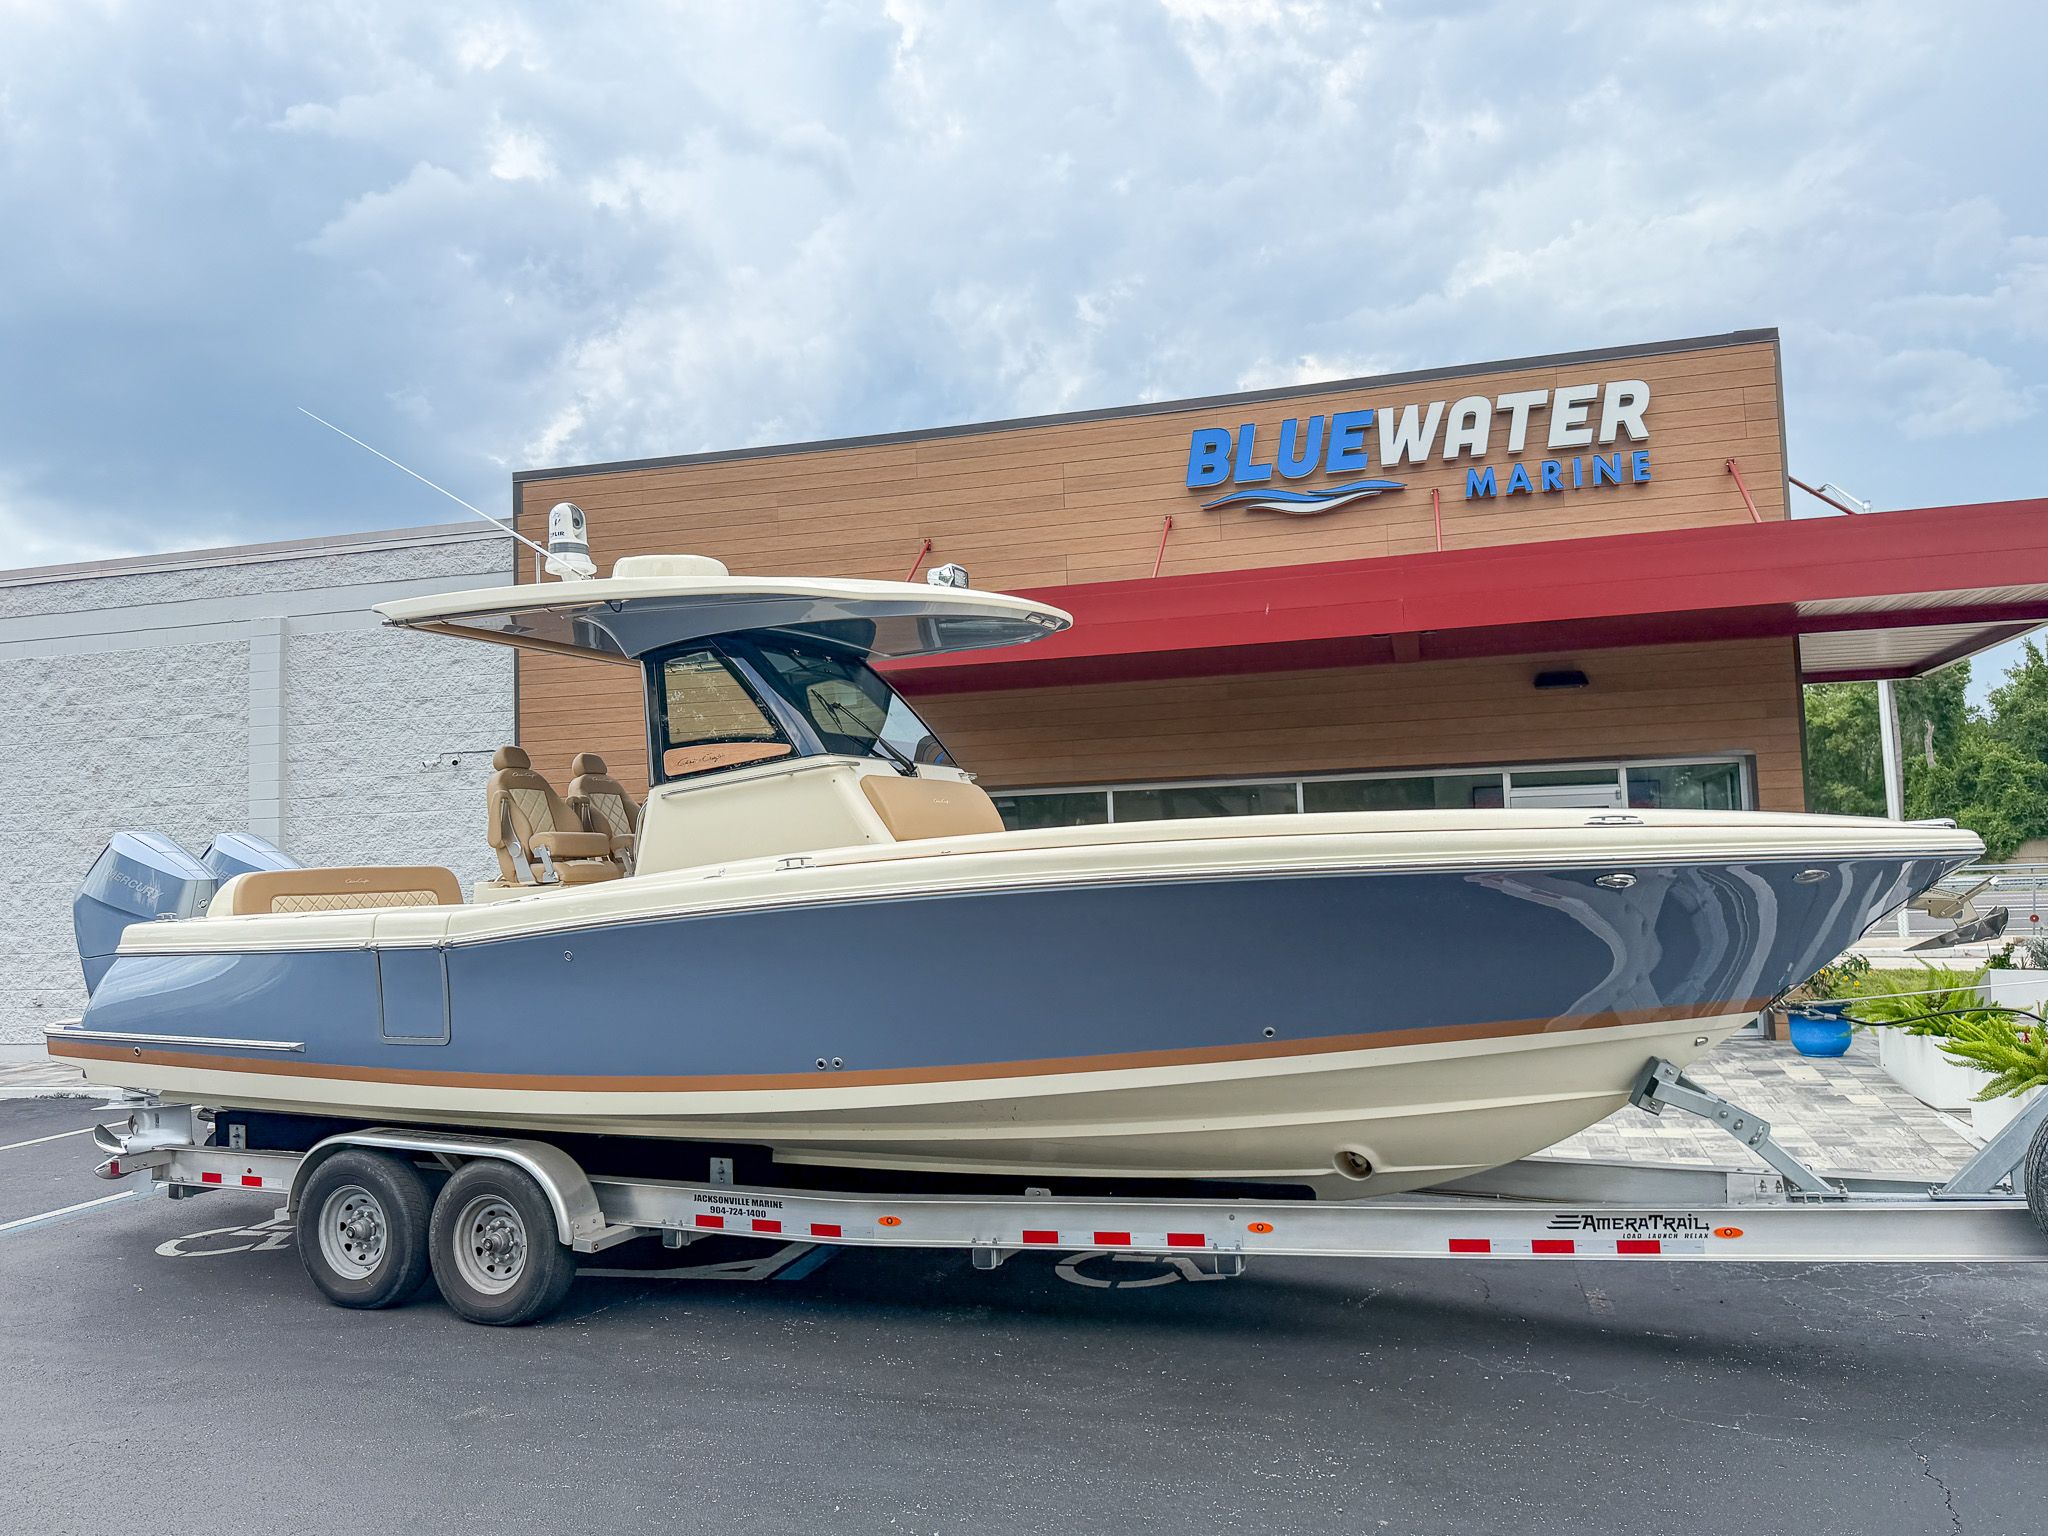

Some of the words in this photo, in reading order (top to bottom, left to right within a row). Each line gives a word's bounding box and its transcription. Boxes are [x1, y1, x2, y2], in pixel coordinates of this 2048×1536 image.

[1465, 450, 1652, 499] MARINE
[693, 1194, 750, 1206] JACKSONVILLE
[752, 1199, 783, 1208] MARINE
[710, 1206, 766, 1217] 904-724-1400
